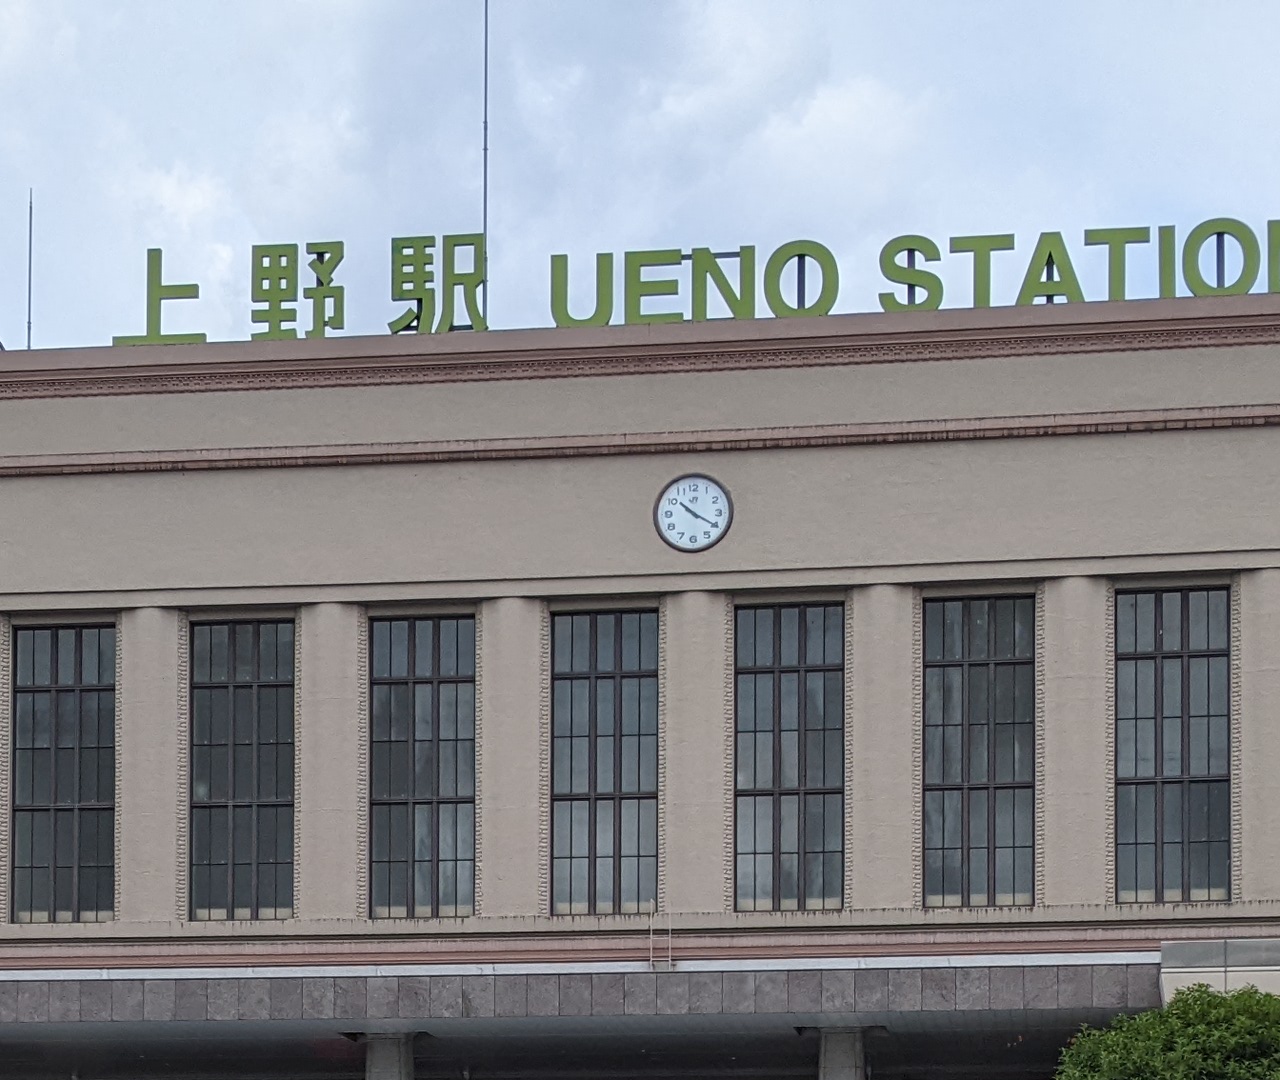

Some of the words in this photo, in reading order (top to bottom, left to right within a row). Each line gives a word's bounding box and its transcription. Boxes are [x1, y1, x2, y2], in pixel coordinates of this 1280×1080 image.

[112, 232, 489, 346] 上野駅
[550, 239, 840, 328] UENO
[688, 484, 699, 493] 12
[668, 498, 678, 506] 10
